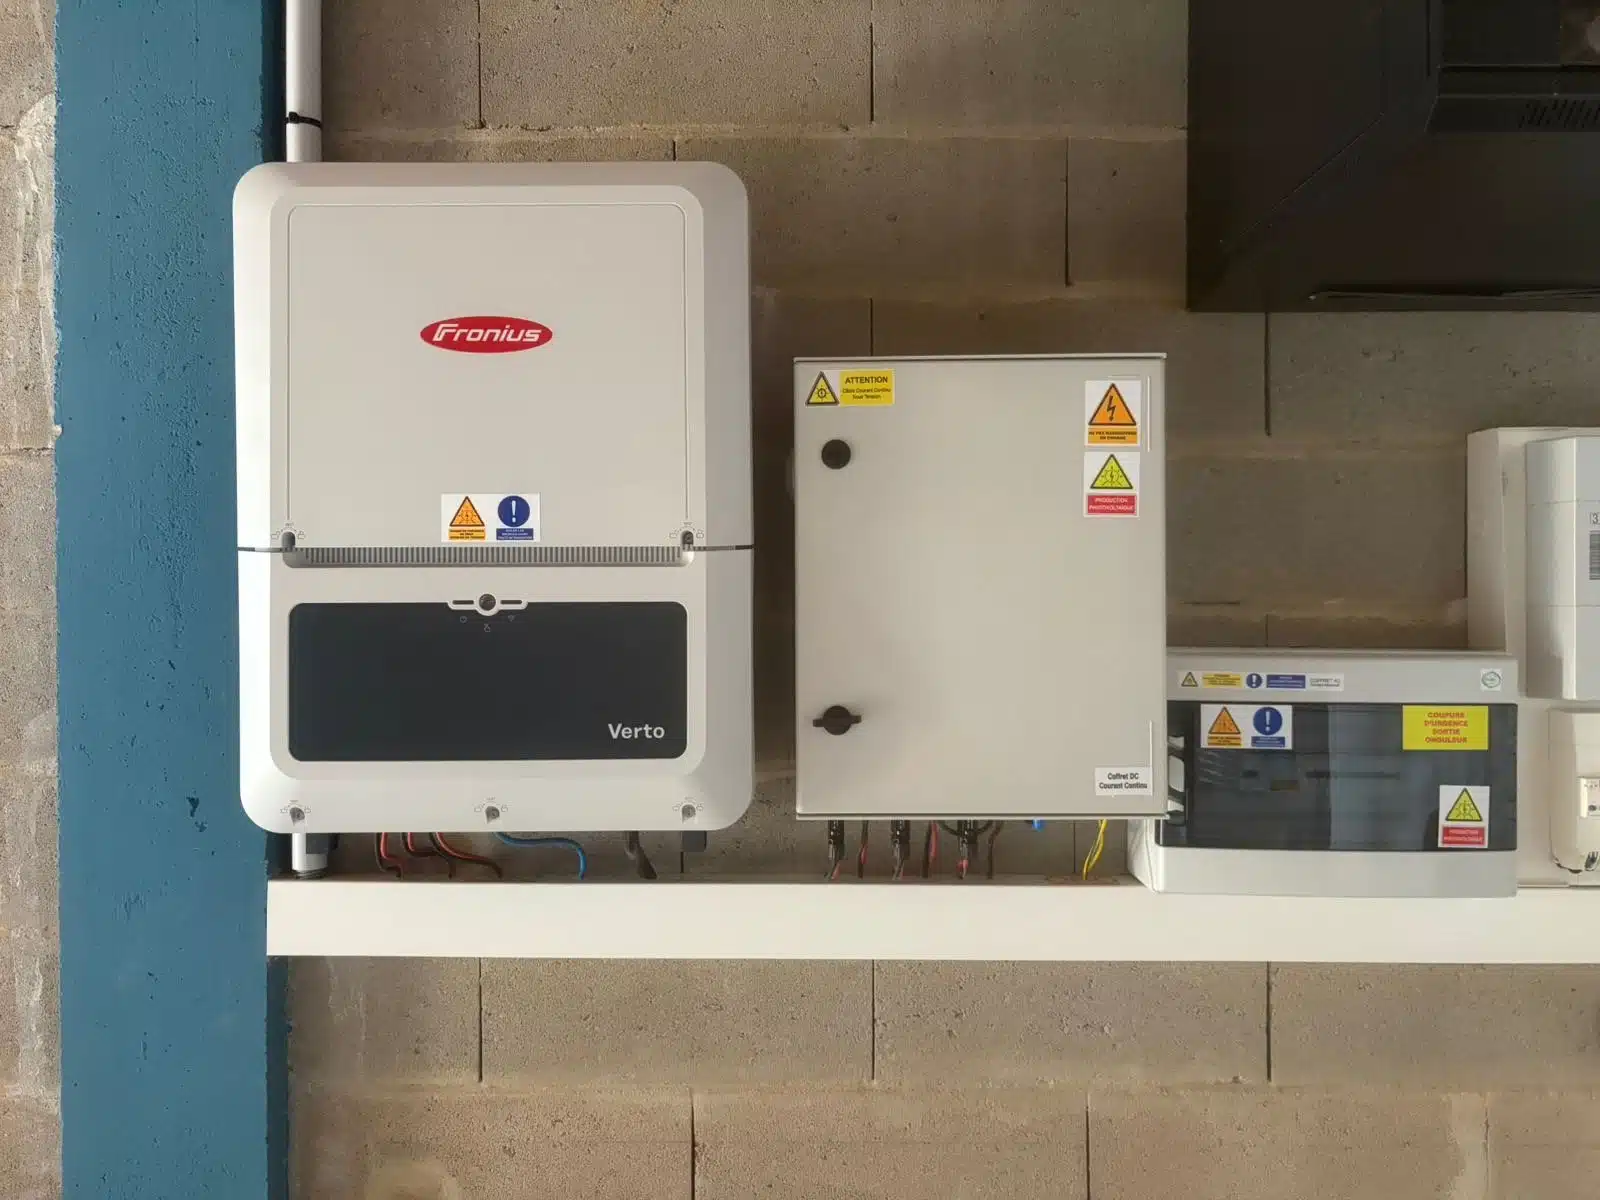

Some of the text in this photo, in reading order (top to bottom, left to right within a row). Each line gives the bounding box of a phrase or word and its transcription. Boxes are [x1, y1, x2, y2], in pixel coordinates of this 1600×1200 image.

[432, 323, 542, 342] Fronius
[845, 376, 888, 384] ATTENTION
[608, 723, 665, 739] Verto
[1107, 772, 1139, 780] Coffret DC
